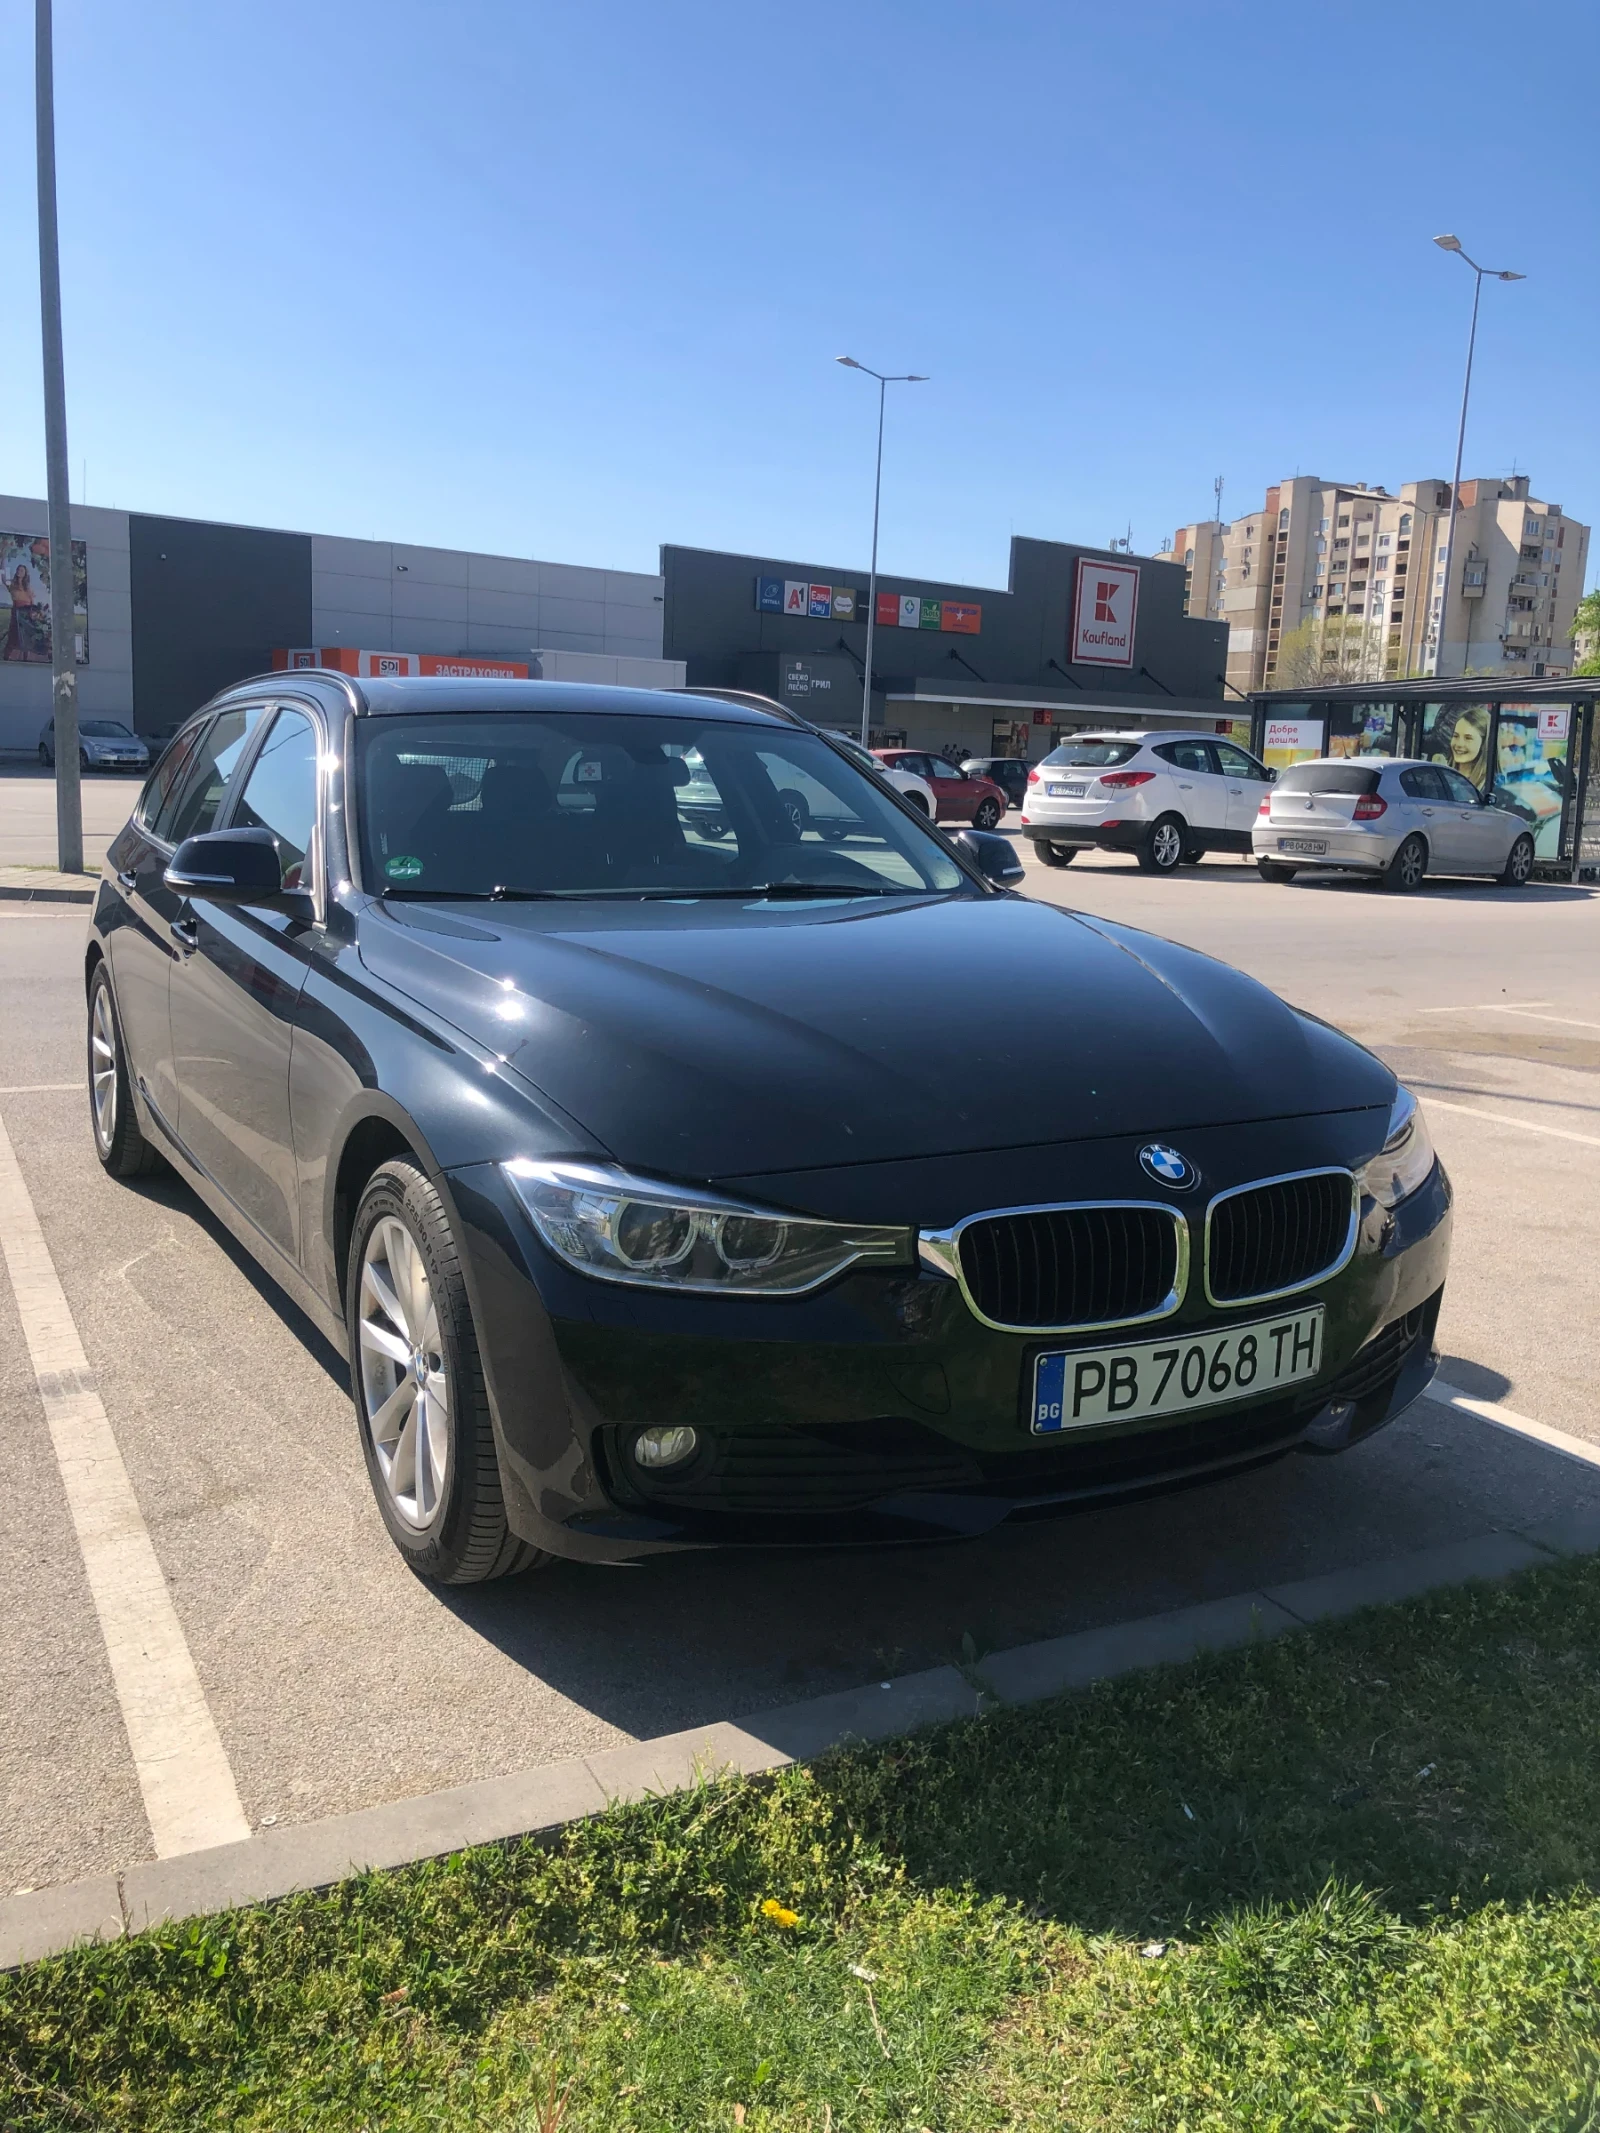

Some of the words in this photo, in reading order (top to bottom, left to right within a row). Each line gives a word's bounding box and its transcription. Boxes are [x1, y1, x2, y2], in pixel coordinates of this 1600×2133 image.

[787, 587, 805, 609] A1
[811, 590, 830, 604] Easy
[811, 601, 826, 614] Pay
[1082, 629, 1126, 647] Kaufland
[381, 660, 398, 671] SDI
[436, 664, 514, 679] ЗАСТРАХОВКИ
[788, 673, 808, 681] СВЕЖО
[788, 683, 808, 691] ЛЕСНО
[811, 680, 830, 689] ГРИЛ
[1269, 724, 1298, 735] Добре
[1268, 737, 1298, 745] дошли
[1142, 1144, 1180, 1160] BMW
[1072, 1356, 1139, 1418] PB
[1149, 1334, 1258, 1406] 7068
[1269, 1317, 1317, 1378] TH
[1038, 1403, 1061, 1420] BG
